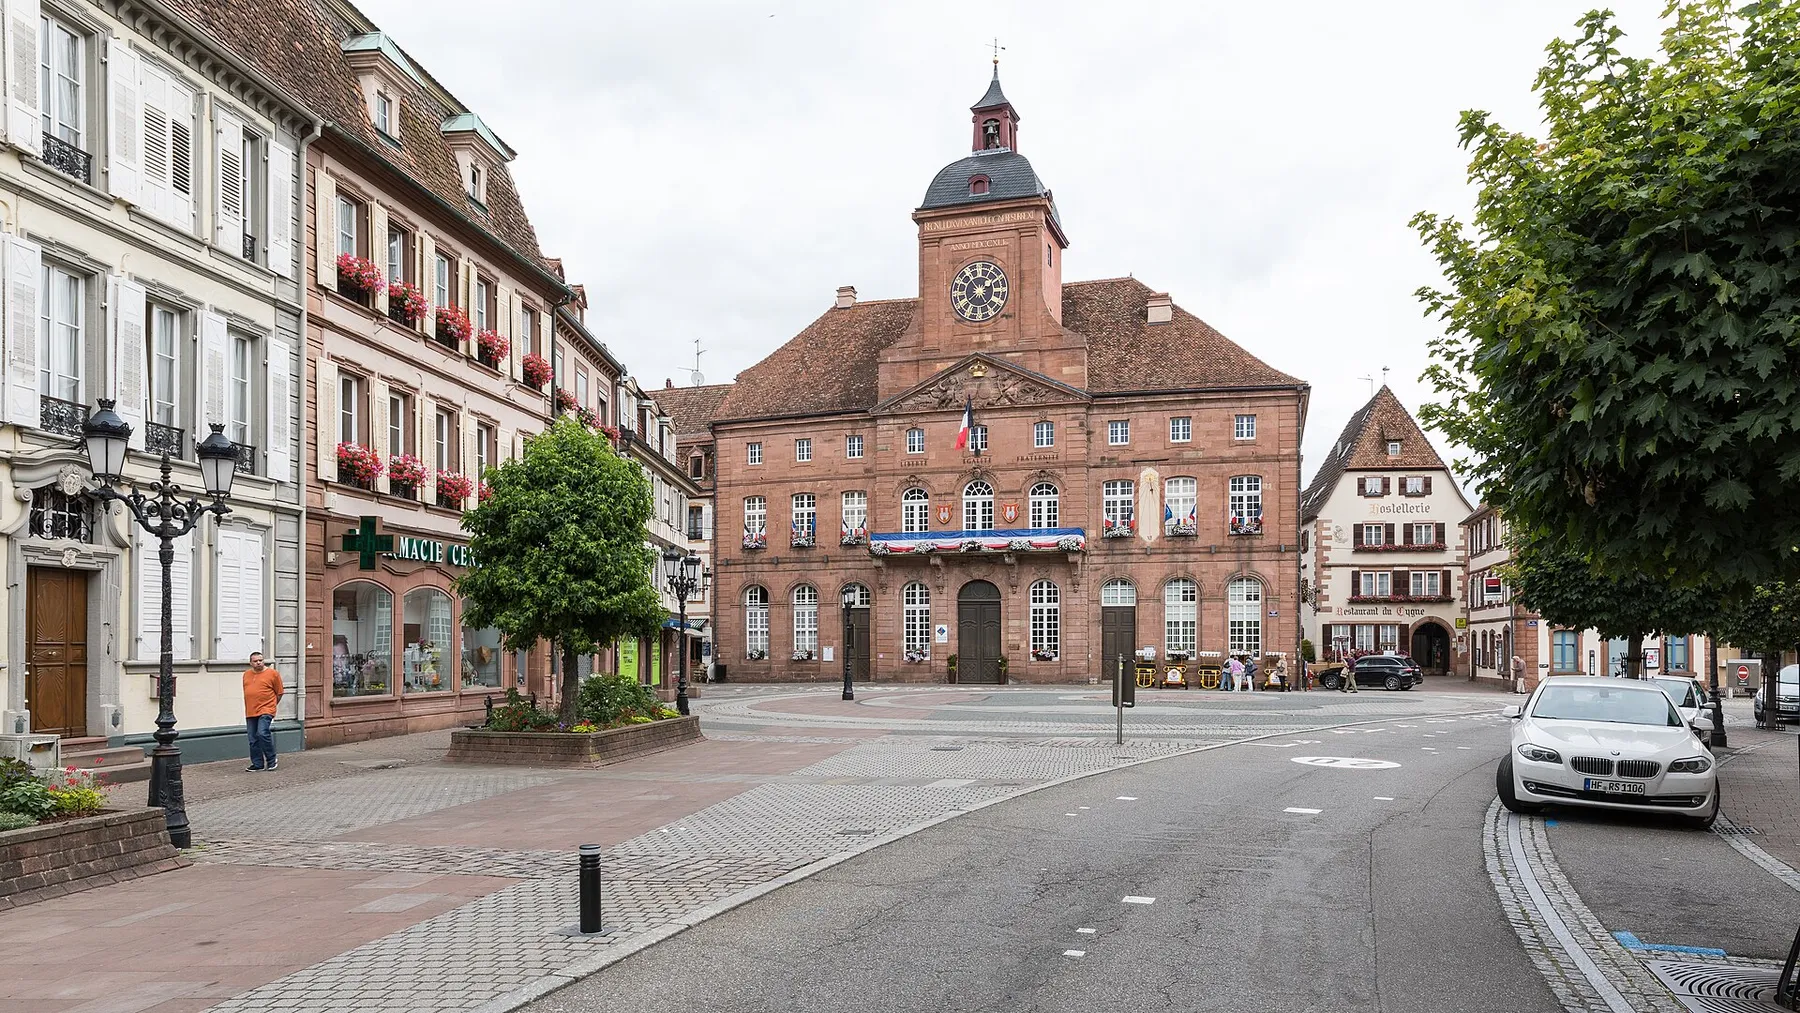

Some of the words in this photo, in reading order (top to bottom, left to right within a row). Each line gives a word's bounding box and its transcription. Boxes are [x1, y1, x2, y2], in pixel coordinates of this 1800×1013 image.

[1369, 503, 1430, 515] Hostellerie
[1336, 606, 1378, 616] Restaurant
[1382, 606, 1392, 616] du
[1396, 606, 1425, 617] Cygne
[1591, 780, 1602, 790] HF
[1608, 782, 1620, 791] RS
[1621, 783, 1643, 793] 1106
